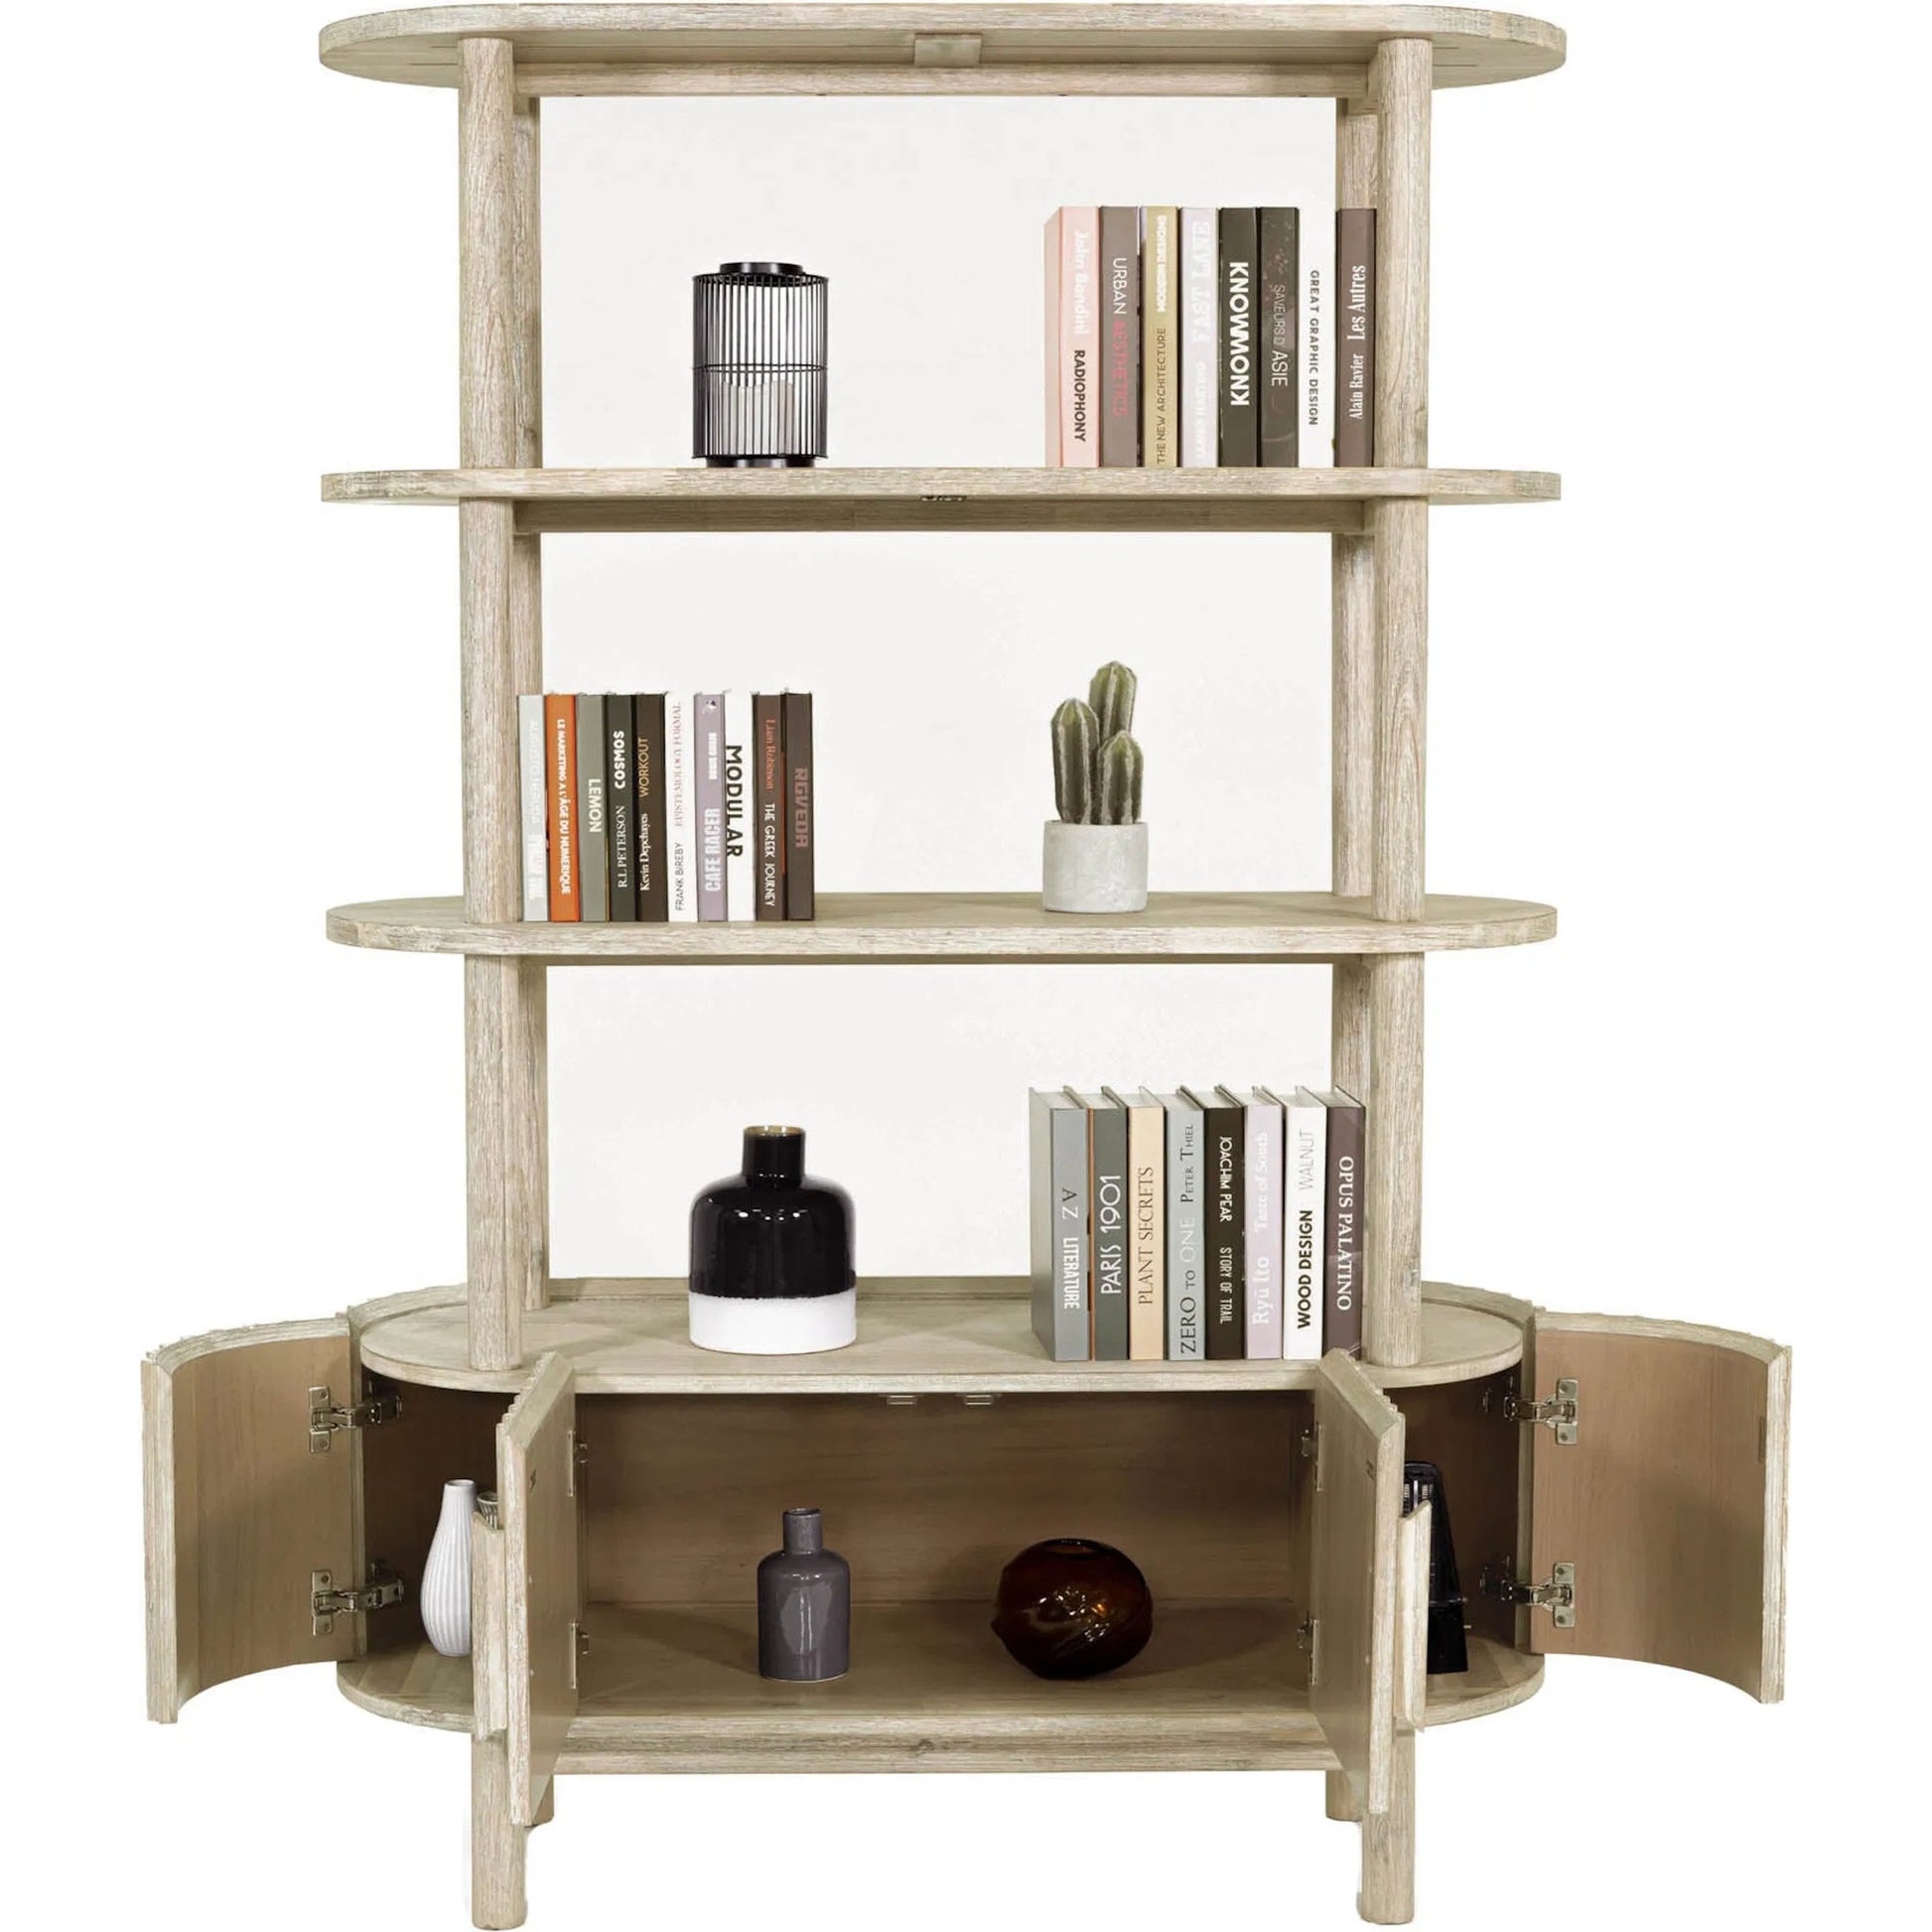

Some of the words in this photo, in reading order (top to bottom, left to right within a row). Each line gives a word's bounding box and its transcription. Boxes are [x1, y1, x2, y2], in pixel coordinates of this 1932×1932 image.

[1112, 257, 1128, 315] URBAN
[1272, 284, 1287, 335] SAVEURS
[1310, 270, 1320, 313] GREAT
[1347, 264, 1366, 313] Autres
[1309, 319, 1319, 374] GRAPHIC
[1346, 316, 1365, 341] Les
[1112, 320, 1129, 416] AESTHETICS
[1156, 328, 1167, 411] ARCHITECTURE
[1349, 353, 1364, 385] Ravier
[1074, 349, 1086, 442] RADIOPHONY
[1308, 378, 1318, 426] DESIGN
[1348, 387, 1363, 420] Alain
[1157, 416, 1166, 440] NEW
[1157, 443, 1166, 464] THE
[556, 719, 565, 729] LE
[557, 731, 567, 780] MARKETING
[613, 730, 624, 789] COSMOS
[637, 737, 648, 798] WORKOUT
[560, 820, 569, 833] DU
[588, 778, 602, 833] LEMON
[726, 745, 743, 858] MODULAR
[764, 802, 775, 825] THE
[616, 805, 626, 867] PETERSON
[704, 808, 721, 851] RACER
[764, 827, 775, 858] GREEK
[560, 836, 571, 895] NUMERIQUE
[639, 865, 650, 892] Kevin
[764, 862, 775, 906] JOURNEY
[675, 880, 684, 911] FRANK
[1219, 1136, 1233, 1189] JOACHIM
[1299, 1128, 1315, 1190] WALNUT
[1337, 1155, 1354, 1208] OPUS
[1099, 1174, 1122, 1233] 1901
[1138, 1167, 1154, 1243] SECRETS
[1219, 1193, 1233, 1223] PEAR
[1179, 1217, 1196, 1263] ONE
[1219, 1247, 1233, 1275] STORY
[1298, 1210, 1312, 1270] DESIGN
[1336, 1212, 1353, 1311] PALATINO
[1063, 1237, 1080, 1310] LITERATURE
[1100, 1244, 1122, 1295] PARIS
[1138, 1247, 1154, 1306] PLANT
[1219, 1282, 1232, 1297] OF
[1253, 1256, 1270, 1283] Ito
[1180, 1297, 1196, 1354] ZERO
[1219, 1301, 1233, 1324] TRAIL
[1297, 1275, 1311, 1329] WOOD
